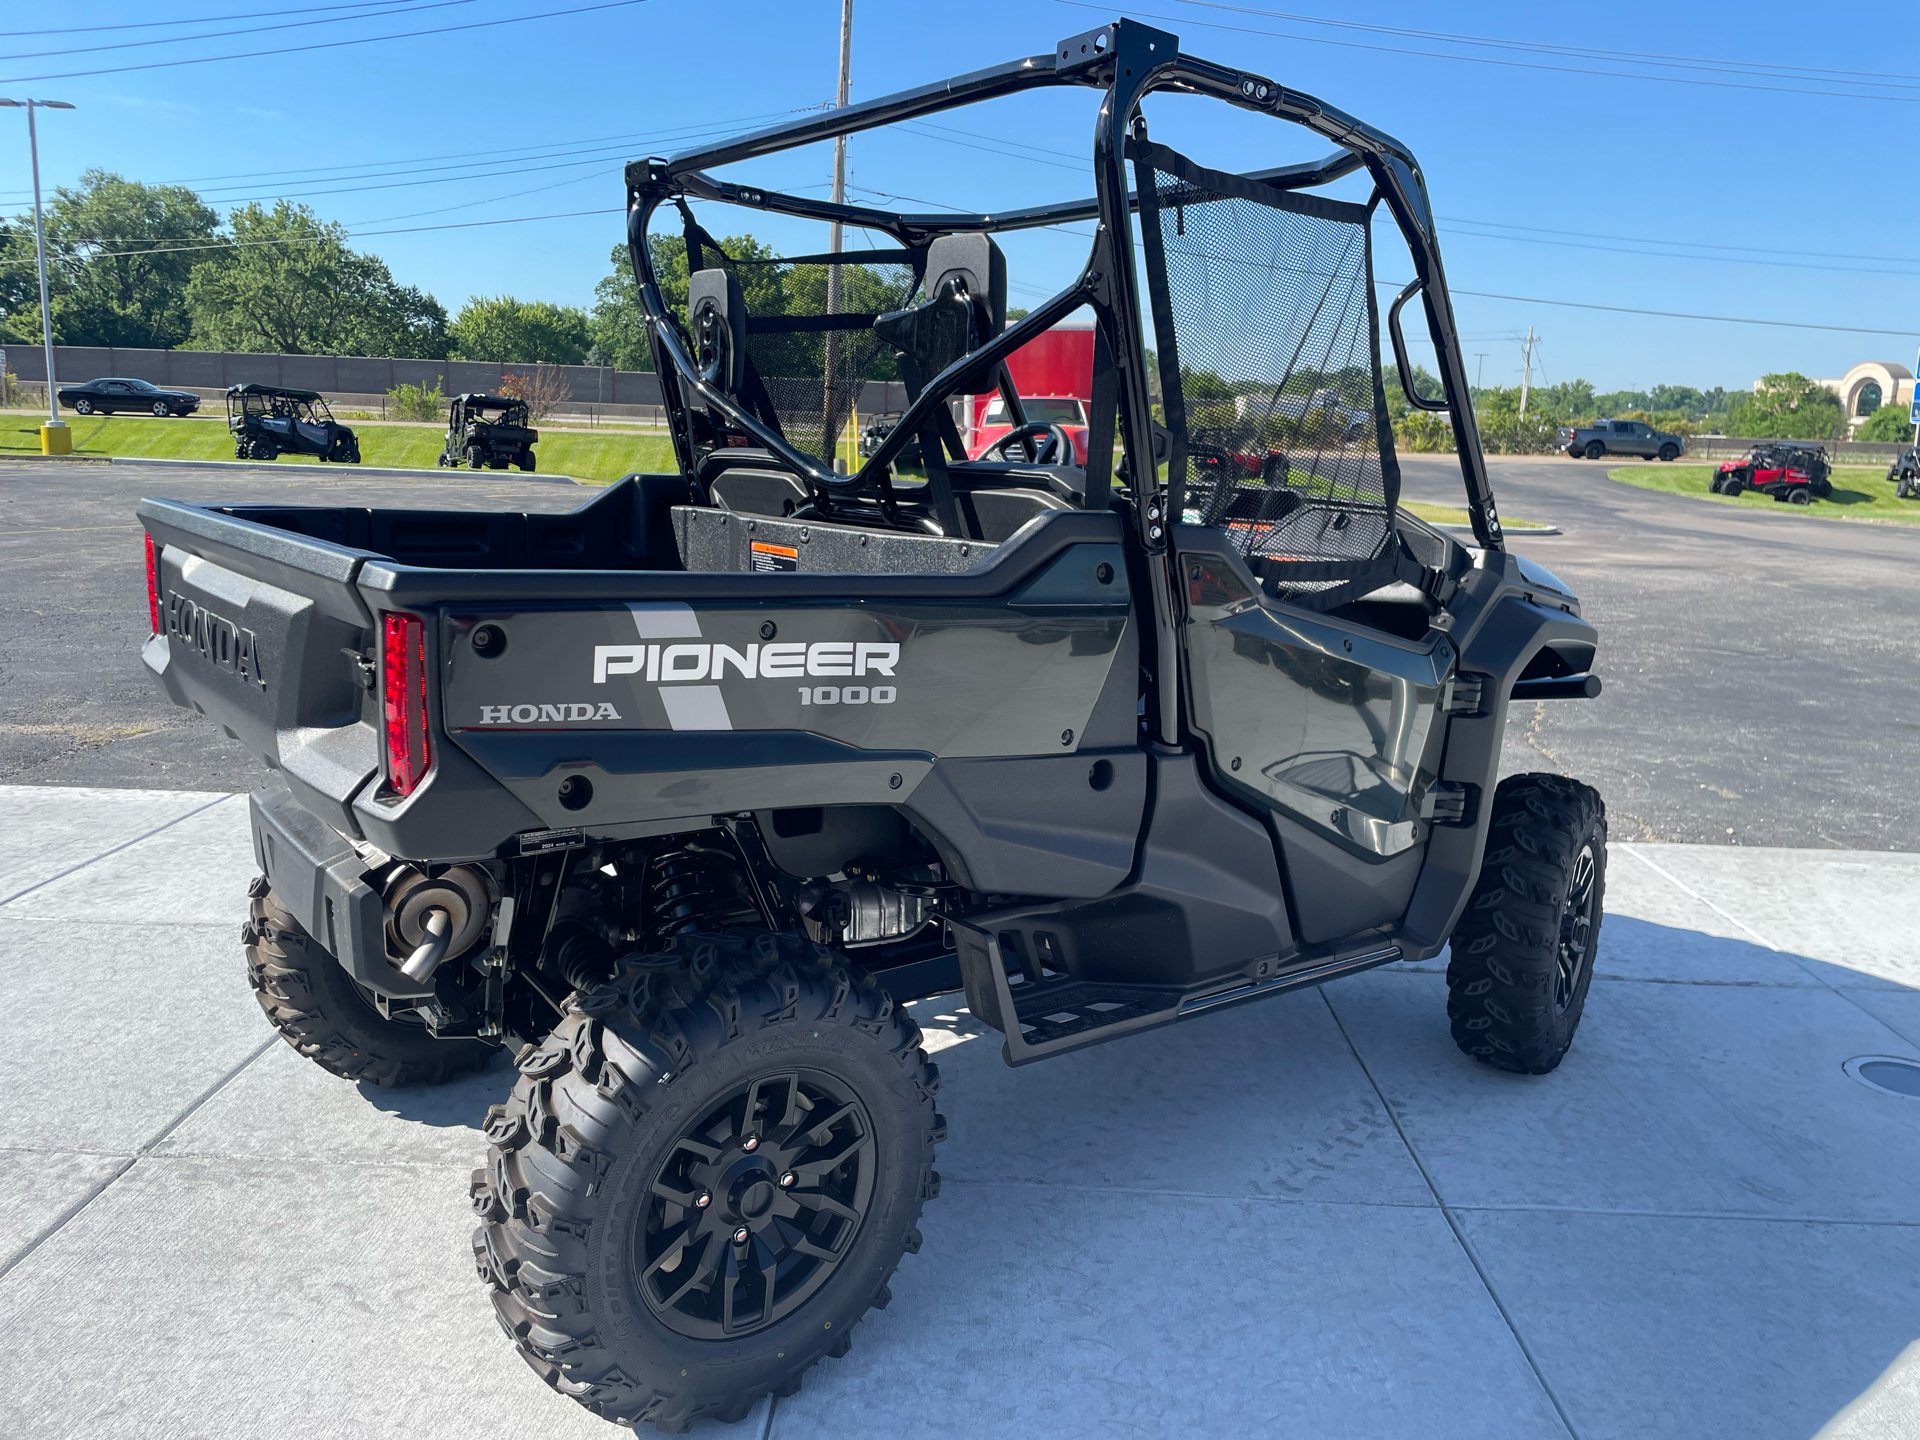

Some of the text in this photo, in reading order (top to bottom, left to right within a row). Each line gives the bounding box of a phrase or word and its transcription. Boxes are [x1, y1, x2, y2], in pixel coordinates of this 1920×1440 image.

[169, 590, 267, 692] HONDA
[593, 642, 900, 684] PIONEER
[798, 685, 897, 706] 1000
[480, 702, 622, 724] HONDA
